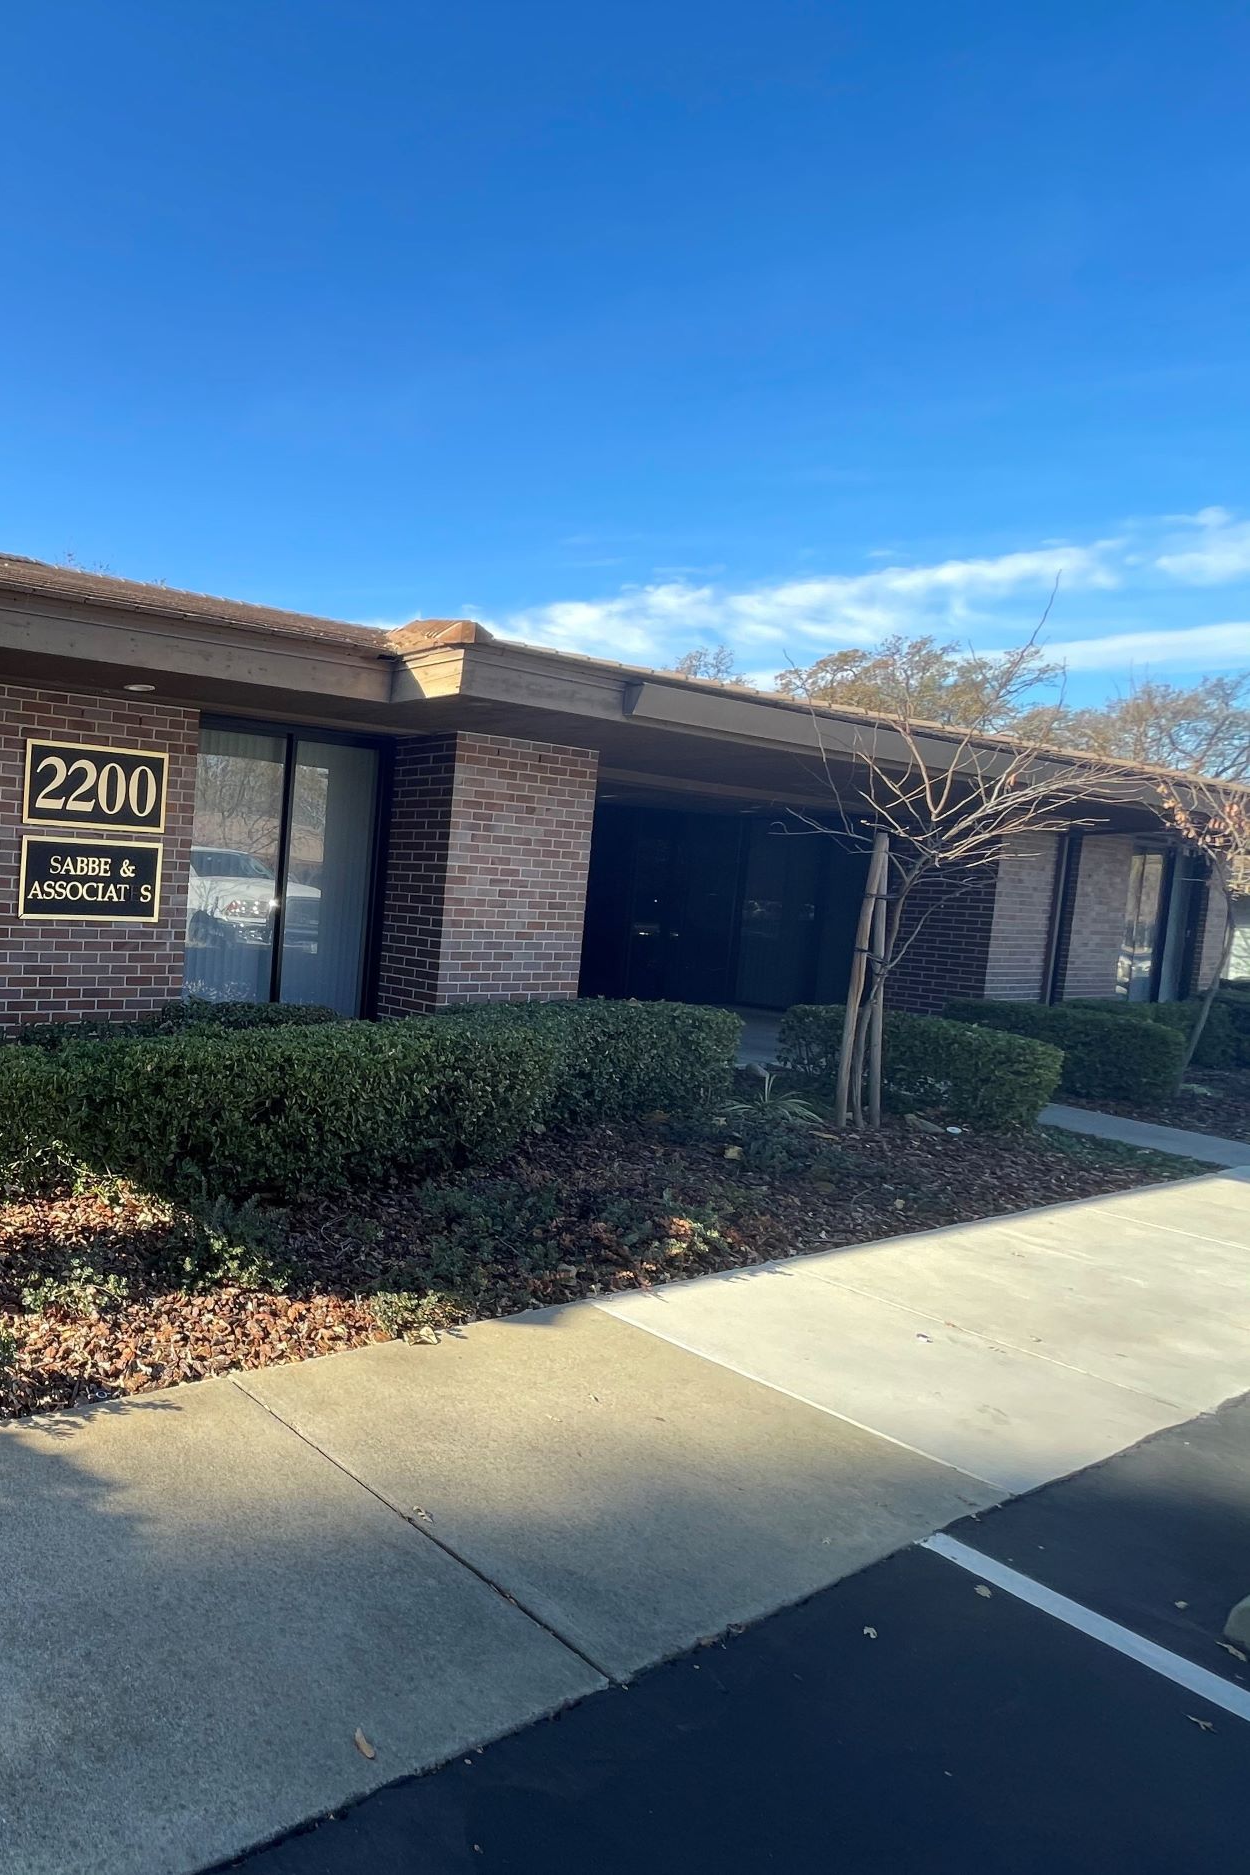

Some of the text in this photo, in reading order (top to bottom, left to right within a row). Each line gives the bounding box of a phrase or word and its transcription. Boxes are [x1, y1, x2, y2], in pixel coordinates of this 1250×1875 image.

[35, 756, 157, 817] 2200
[49, 855, 136, 878] SABBE &
[27, 880, 152, 903] ASSOCIATS
